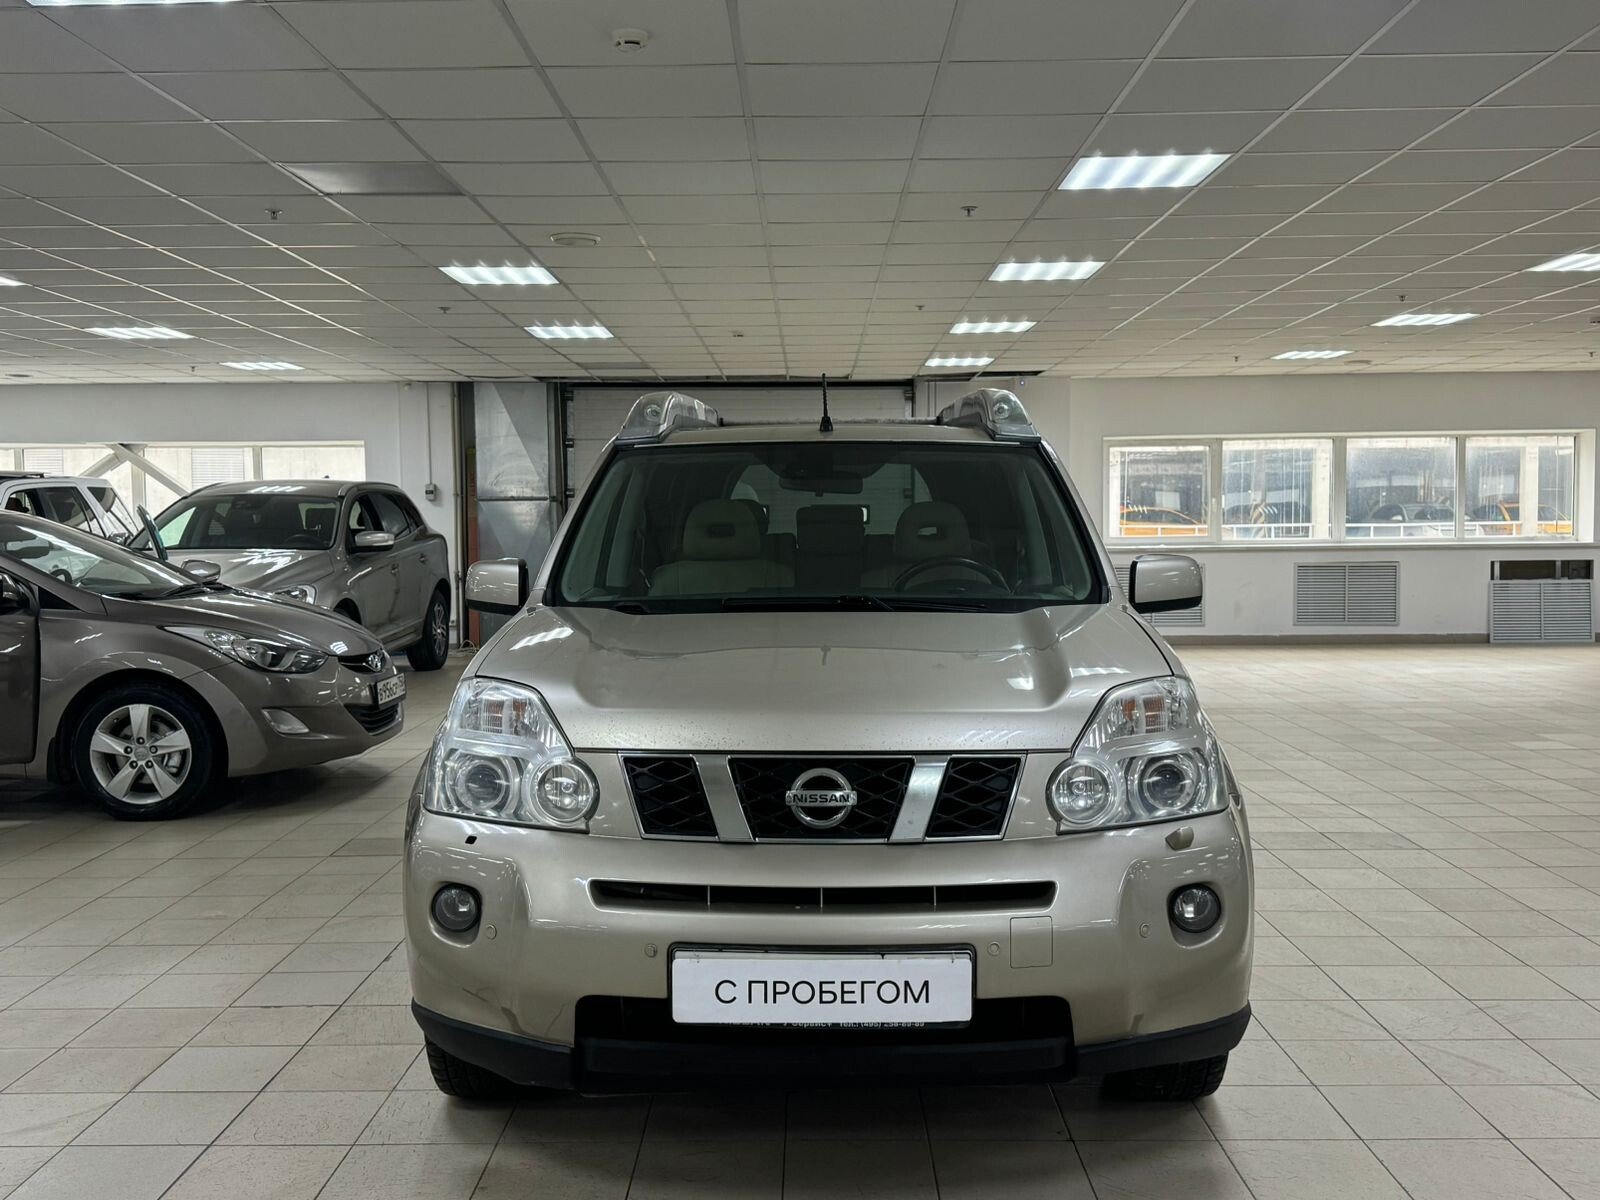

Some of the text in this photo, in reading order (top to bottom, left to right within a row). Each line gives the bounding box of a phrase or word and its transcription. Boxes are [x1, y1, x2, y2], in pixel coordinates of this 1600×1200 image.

[792, 793, 850, 804] NISSAN
[714, 979, 930, 1005] С ПРОБЕГОМ
